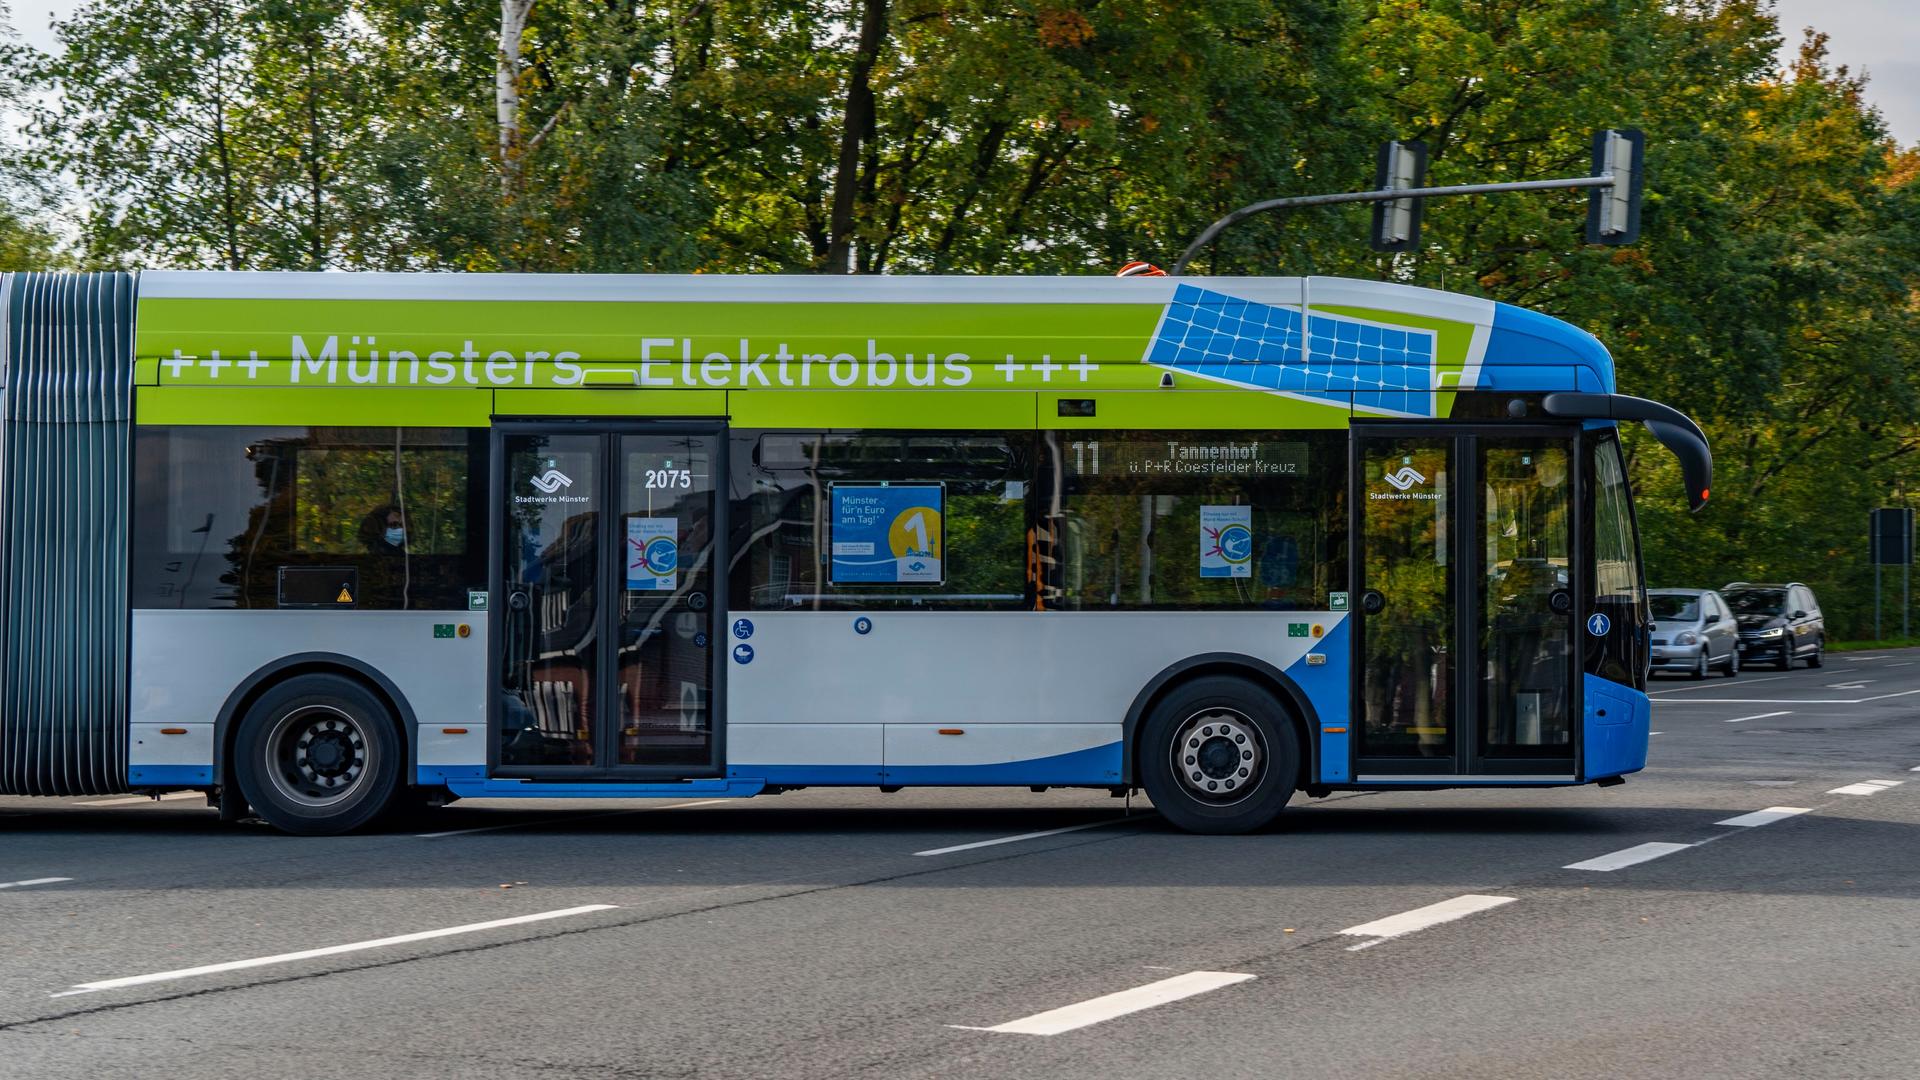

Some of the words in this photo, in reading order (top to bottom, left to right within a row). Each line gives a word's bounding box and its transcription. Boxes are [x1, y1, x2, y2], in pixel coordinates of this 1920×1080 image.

[291, 335, 583, 385] Münsters
[641, 338, 972, 387] Elektrobus
[1072, 441, 1099, 475] 11
[1168, 441, 1259, 460] Tannenhof
[1145, 460, 1172, 473] P+R
[1175, 460, 1250, 473] Coesfelder
[1255, 460, 1296, 473] Kreuz
[645, 469, 691, 489] 2075
[515, 495, 557, 503] Stadtwerke
[559, 495, 590, 503] Münster
[841, 496, 879, 504] Münster
[1370, 492, 1411, 500] Stadtwerke
[1412, 492, 1442, 500] Münster
[864, 506, 886, 514] Euro
[903, 512, 929, 553] 1
